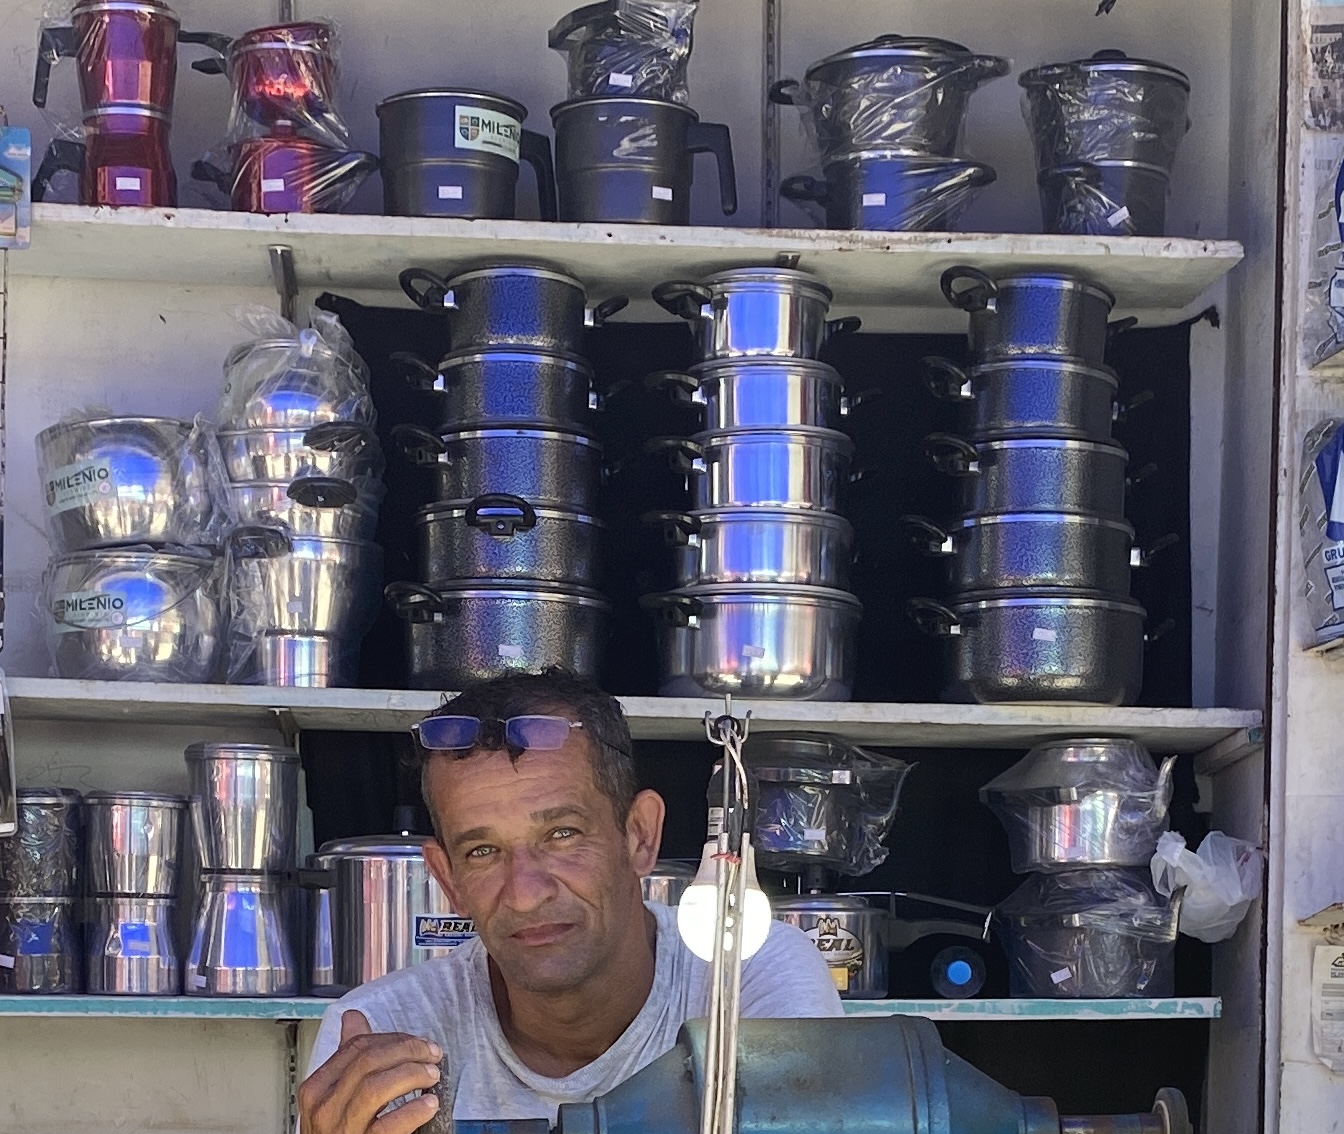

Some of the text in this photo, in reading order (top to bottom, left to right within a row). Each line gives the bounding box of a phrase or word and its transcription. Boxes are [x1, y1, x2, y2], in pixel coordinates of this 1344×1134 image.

[480, 117, 520, 145] MILEN
[55, 465, 109, 493] MILENIO
[65, 594, 124, 613] MILENIO
[811, 938, 854, 952] EAL
